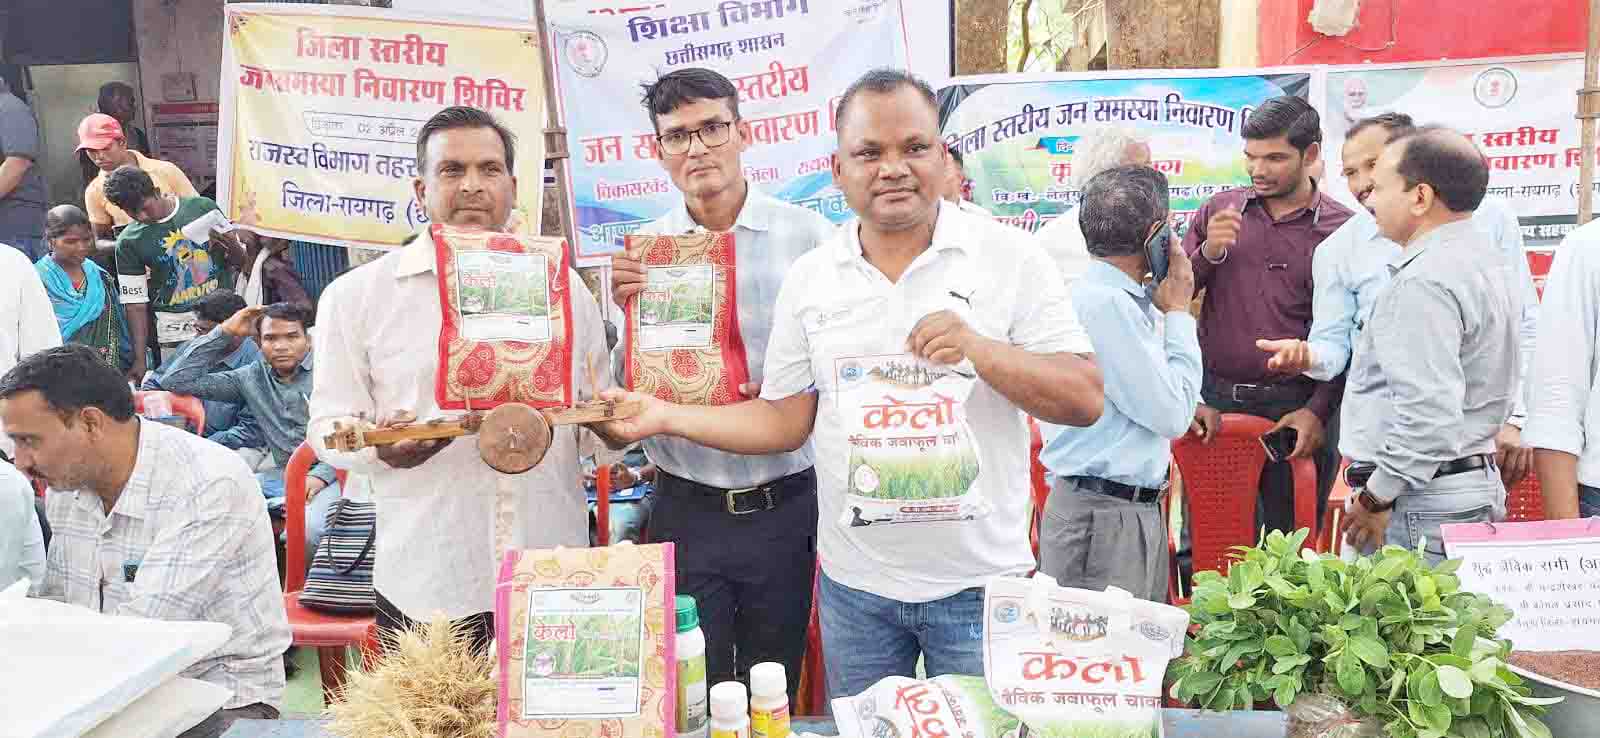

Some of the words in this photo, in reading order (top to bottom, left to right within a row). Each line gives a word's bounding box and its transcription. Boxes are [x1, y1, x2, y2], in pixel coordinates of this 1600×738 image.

[627, 15, 710, 42] शिक्षा
[738, 32, 785, 54] शासन
[296, 26, 363, 61] जिला
[368, 33, 449, 66] स्तरीय
[353, 67, 447, 105] निवारण
[992, 104, 1050, 142] स्तरीय
[1056, 101, 1089, 125] जन
[1095, 100, 1159, 122] समस्या
[1165, 93, 1235, 132] निवारण
[578, 135, 623, 163] जन
[1482, 126, 1560, 148] स्तरीय
[312, 142, 370, 175] विभाग
[861, 394, 961, 430] केलो
[1018, 641, 1147, 684] केलो
[1052, 690, 1119, 713] जवाफूल
